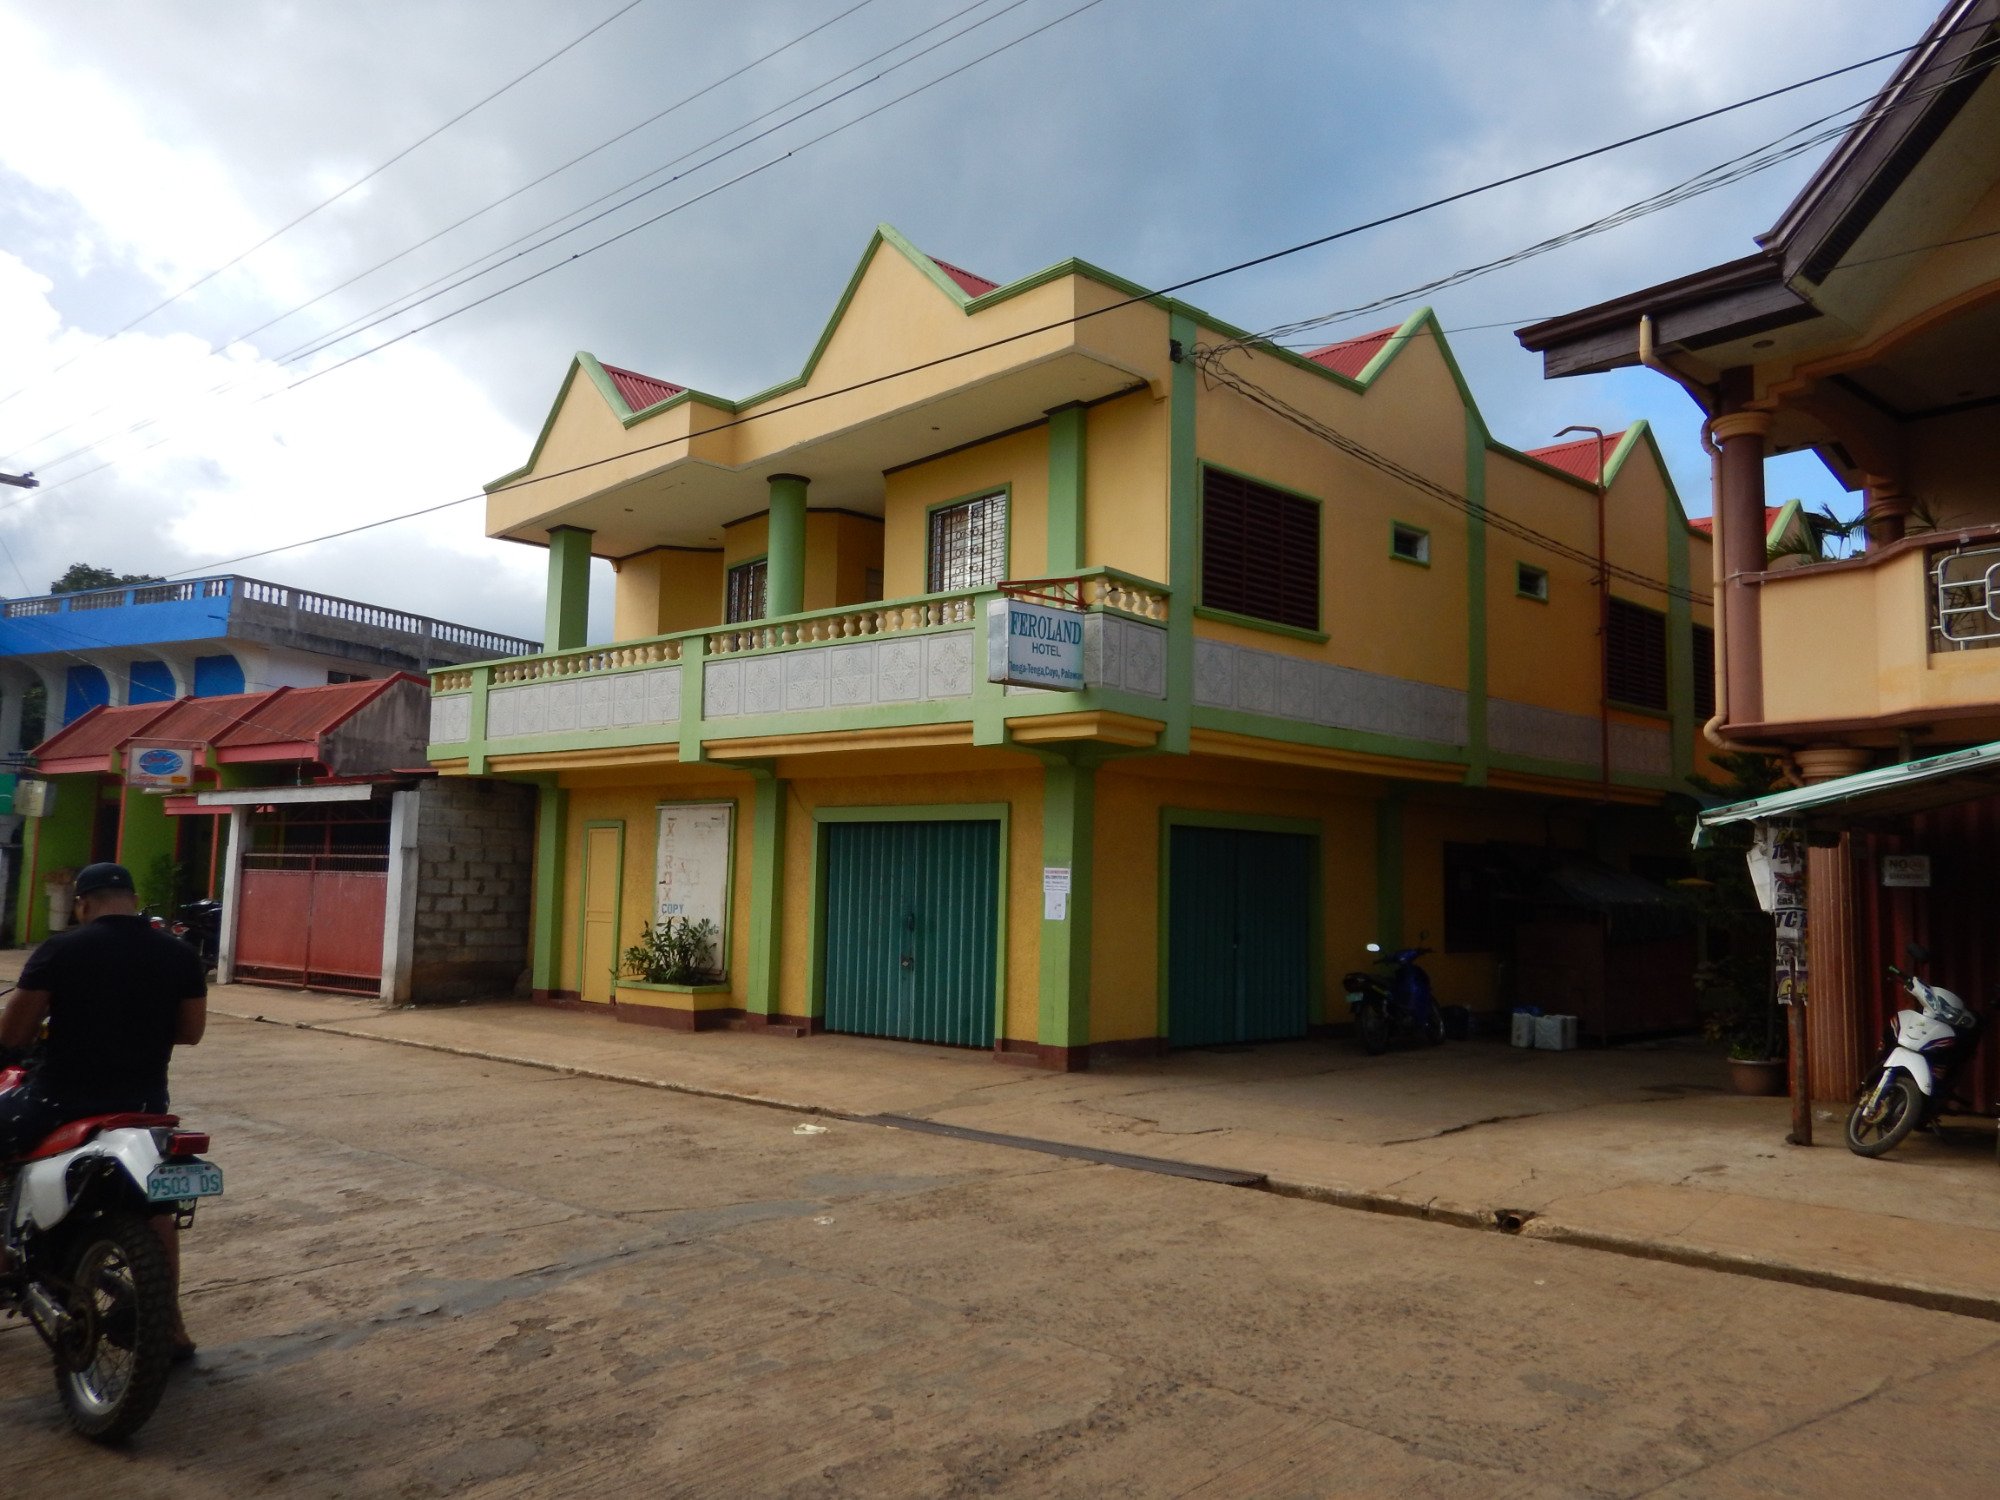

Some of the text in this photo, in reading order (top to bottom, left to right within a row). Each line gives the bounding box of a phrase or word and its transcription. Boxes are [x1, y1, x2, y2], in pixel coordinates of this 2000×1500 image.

[1010, 611, 1082, 645] FEROLAND
[1031, 642, 1061, 657] HOTEL
[1889, 859, 1908, 870] NO
[661, 903, 684, 915] COPY
[151, 1174, 220, 1197] 9503 DS
